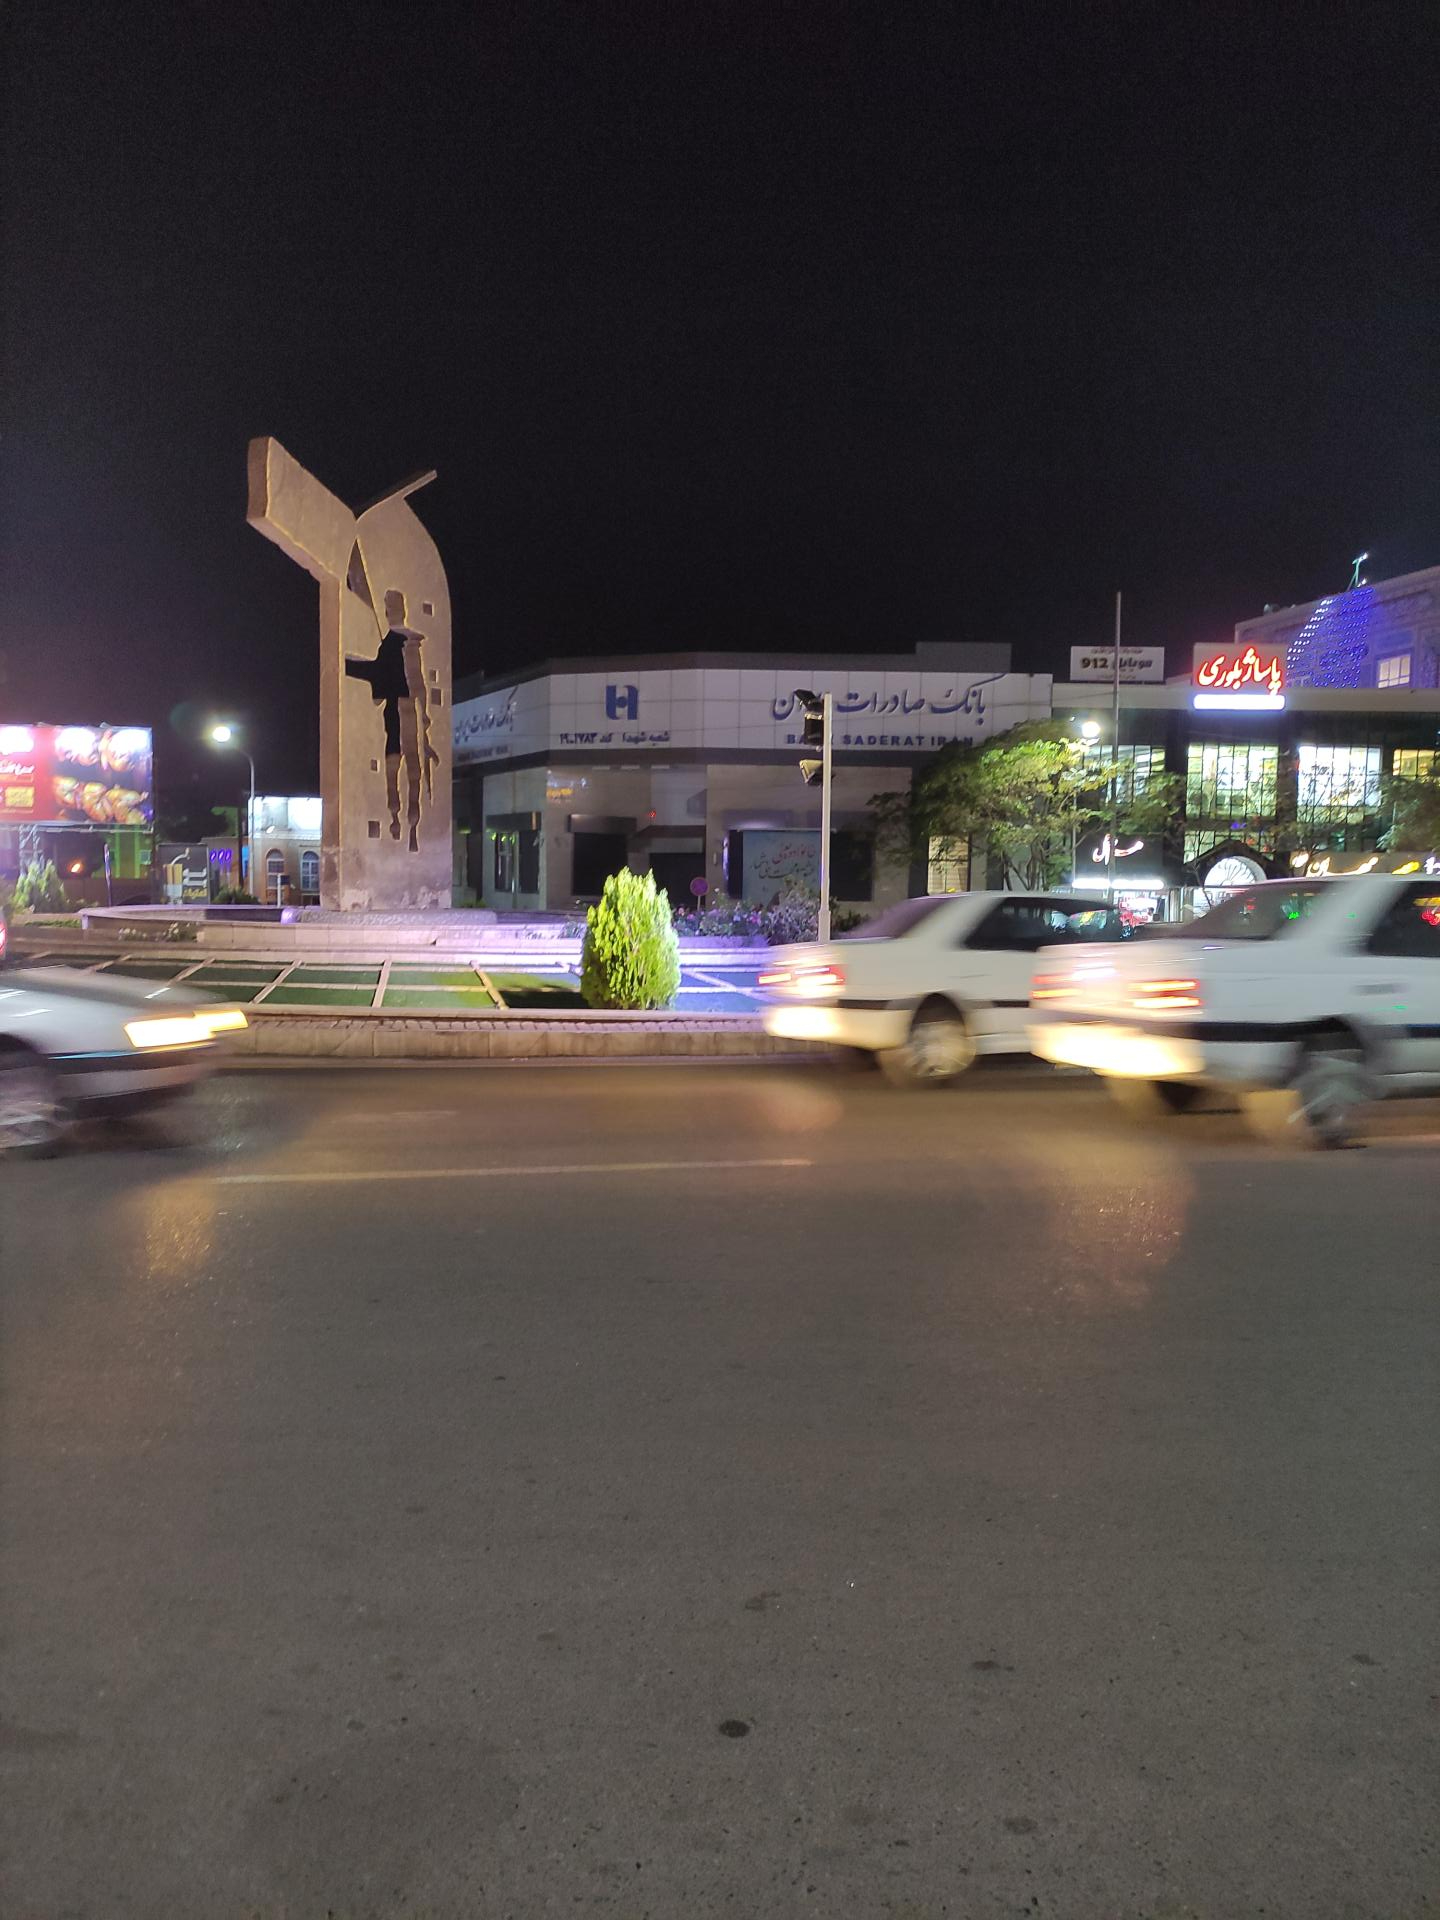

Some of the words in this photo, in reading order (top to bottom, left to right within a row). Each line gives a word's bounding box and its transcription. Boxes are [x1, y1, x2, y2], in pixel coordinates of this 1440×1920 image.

[1081, 657, 1109, 669] 912
[1198, 656, 1243, 690] بلوری
[1237, 647, 1282, 696] پاساژ
[836, 688, 926, 713] صادرات
[929, 673, 1008, 726] بانک
[843, 734, 925, 747] SADERAT
